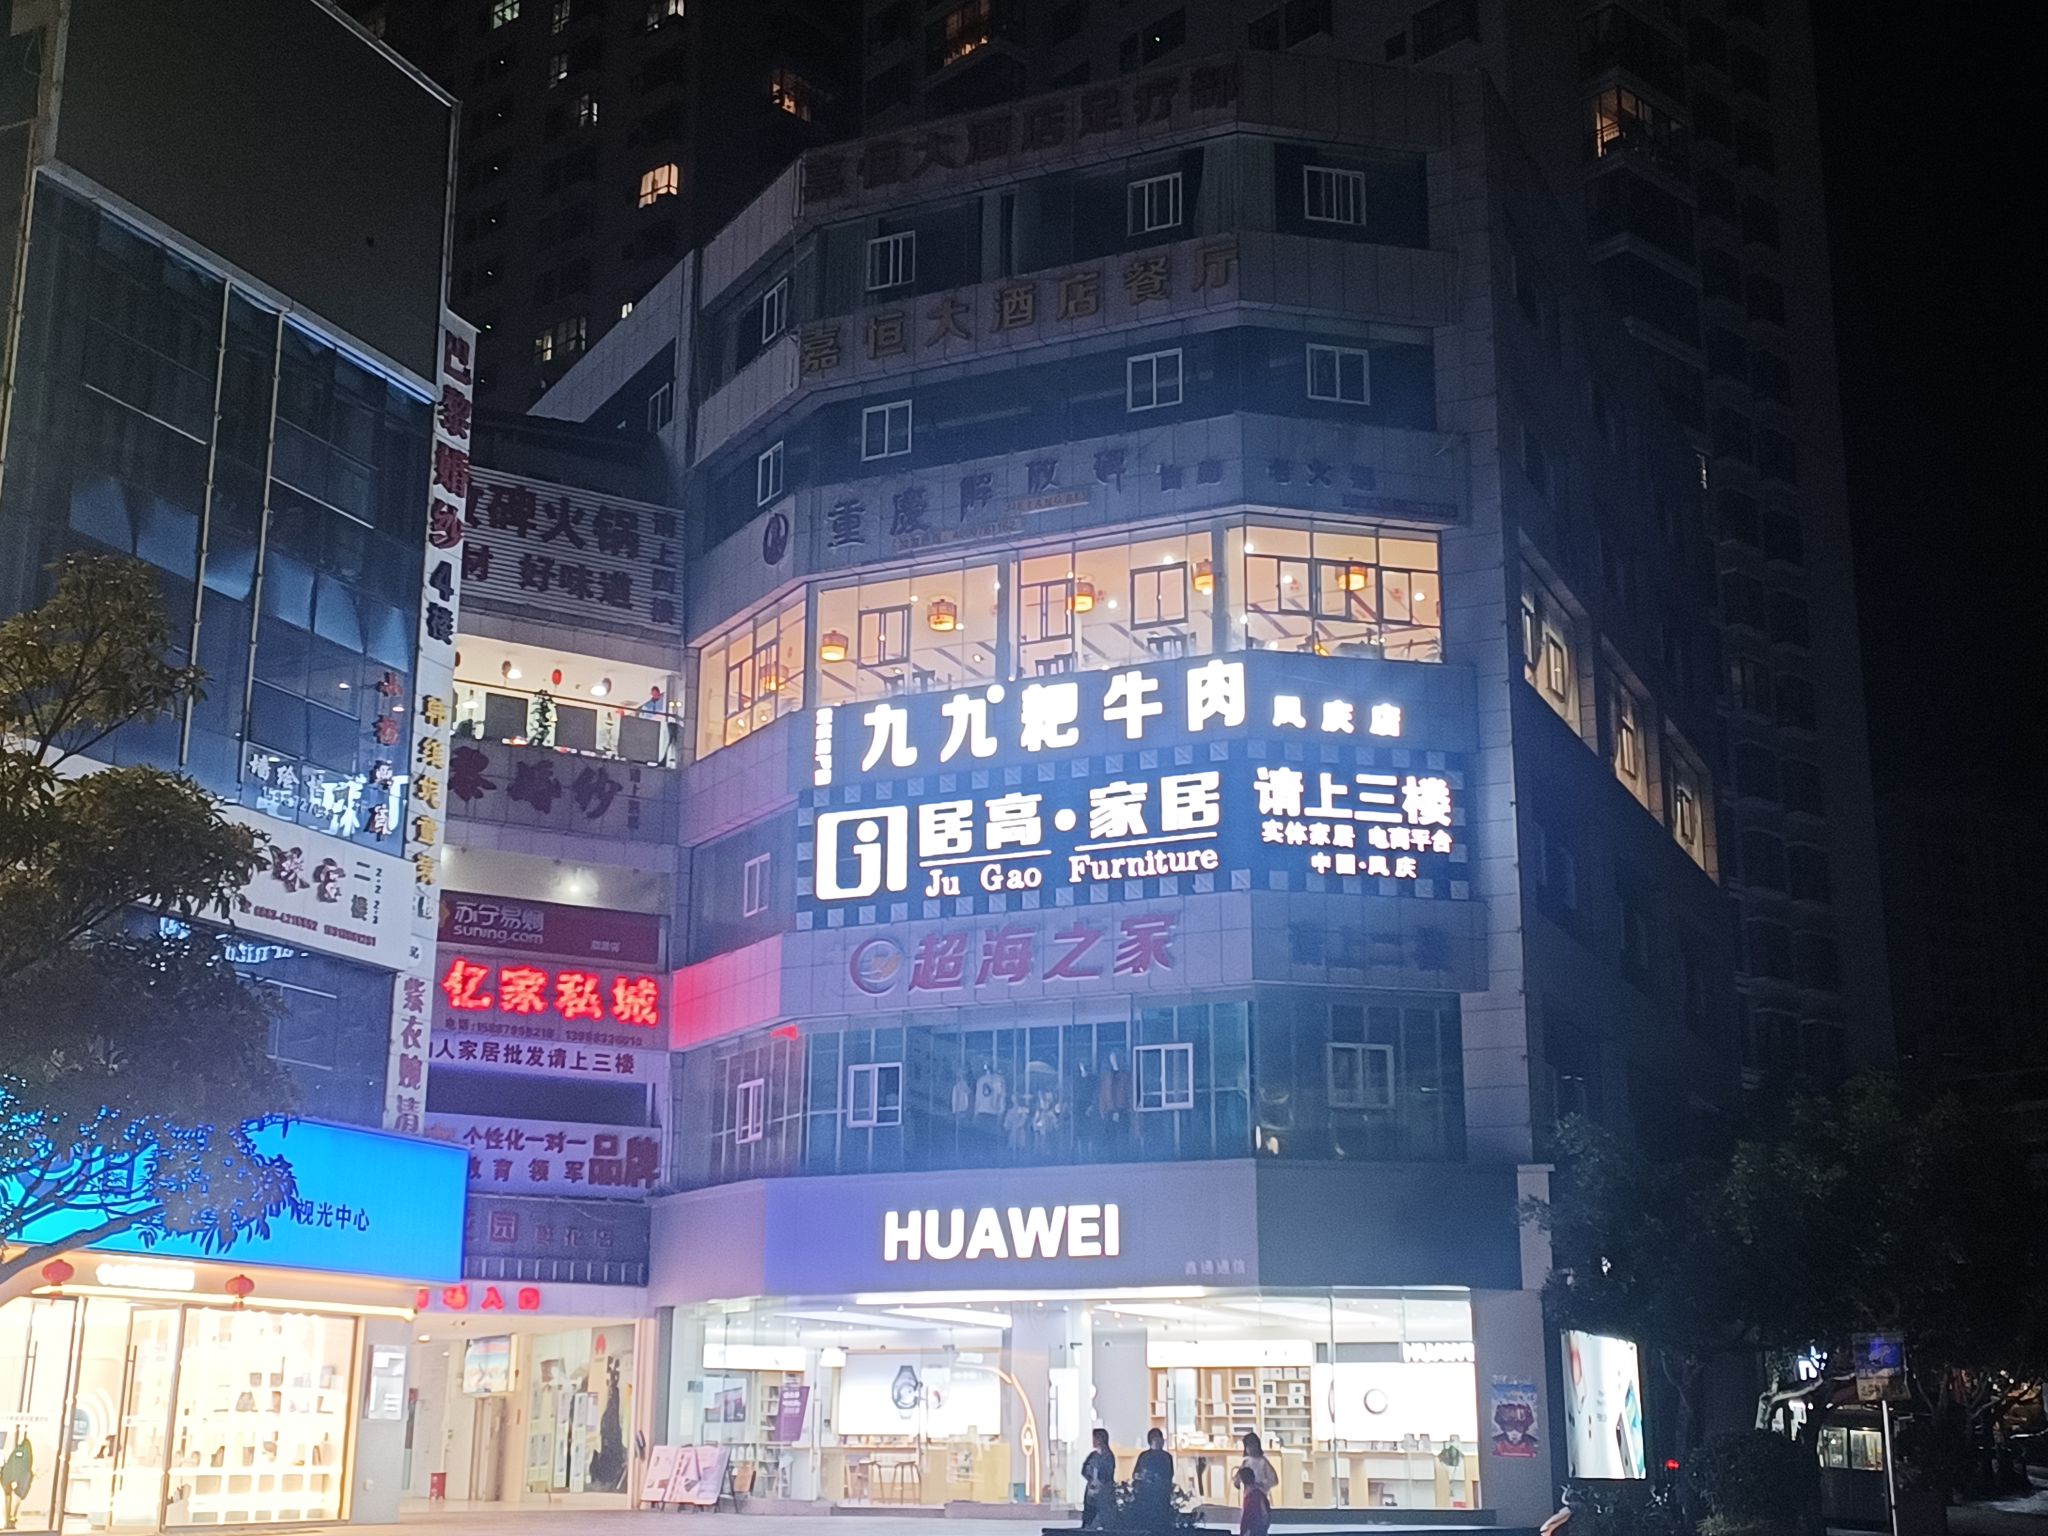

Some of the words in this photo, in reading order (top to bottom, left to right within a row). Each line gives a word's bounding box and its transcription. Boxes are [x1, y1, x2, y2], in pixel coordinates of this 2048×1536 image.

[801, 241, 1240, 376] 嘉恒大酒店餐厅
[918, 771, 1220, 857] 居高·家居
[1253, 766, 1451, 826] 请上三楼
[1261, 818, 1356, 848] 实体家居
[1368, 825, 1453, 853] 电商平台
[925, 868, 960, 898] Ju
[980, 863, 1042, 892] Gao
[1068, 848, 1219, 883] Furniture
[453, 923, 544, 944] suning.com
[454, 901, 545, 931] 苏宁易购
[908, 912, 1177, 993] 超海之家
[443, 958, 660, 1027] 亿家私城
[430, 1038, 635, 1075] 人家居批发请上三楼
[463, 1126, 587, 1154] 个性化一对一
[883, 1203, 1121, 1261] HUAWEI
